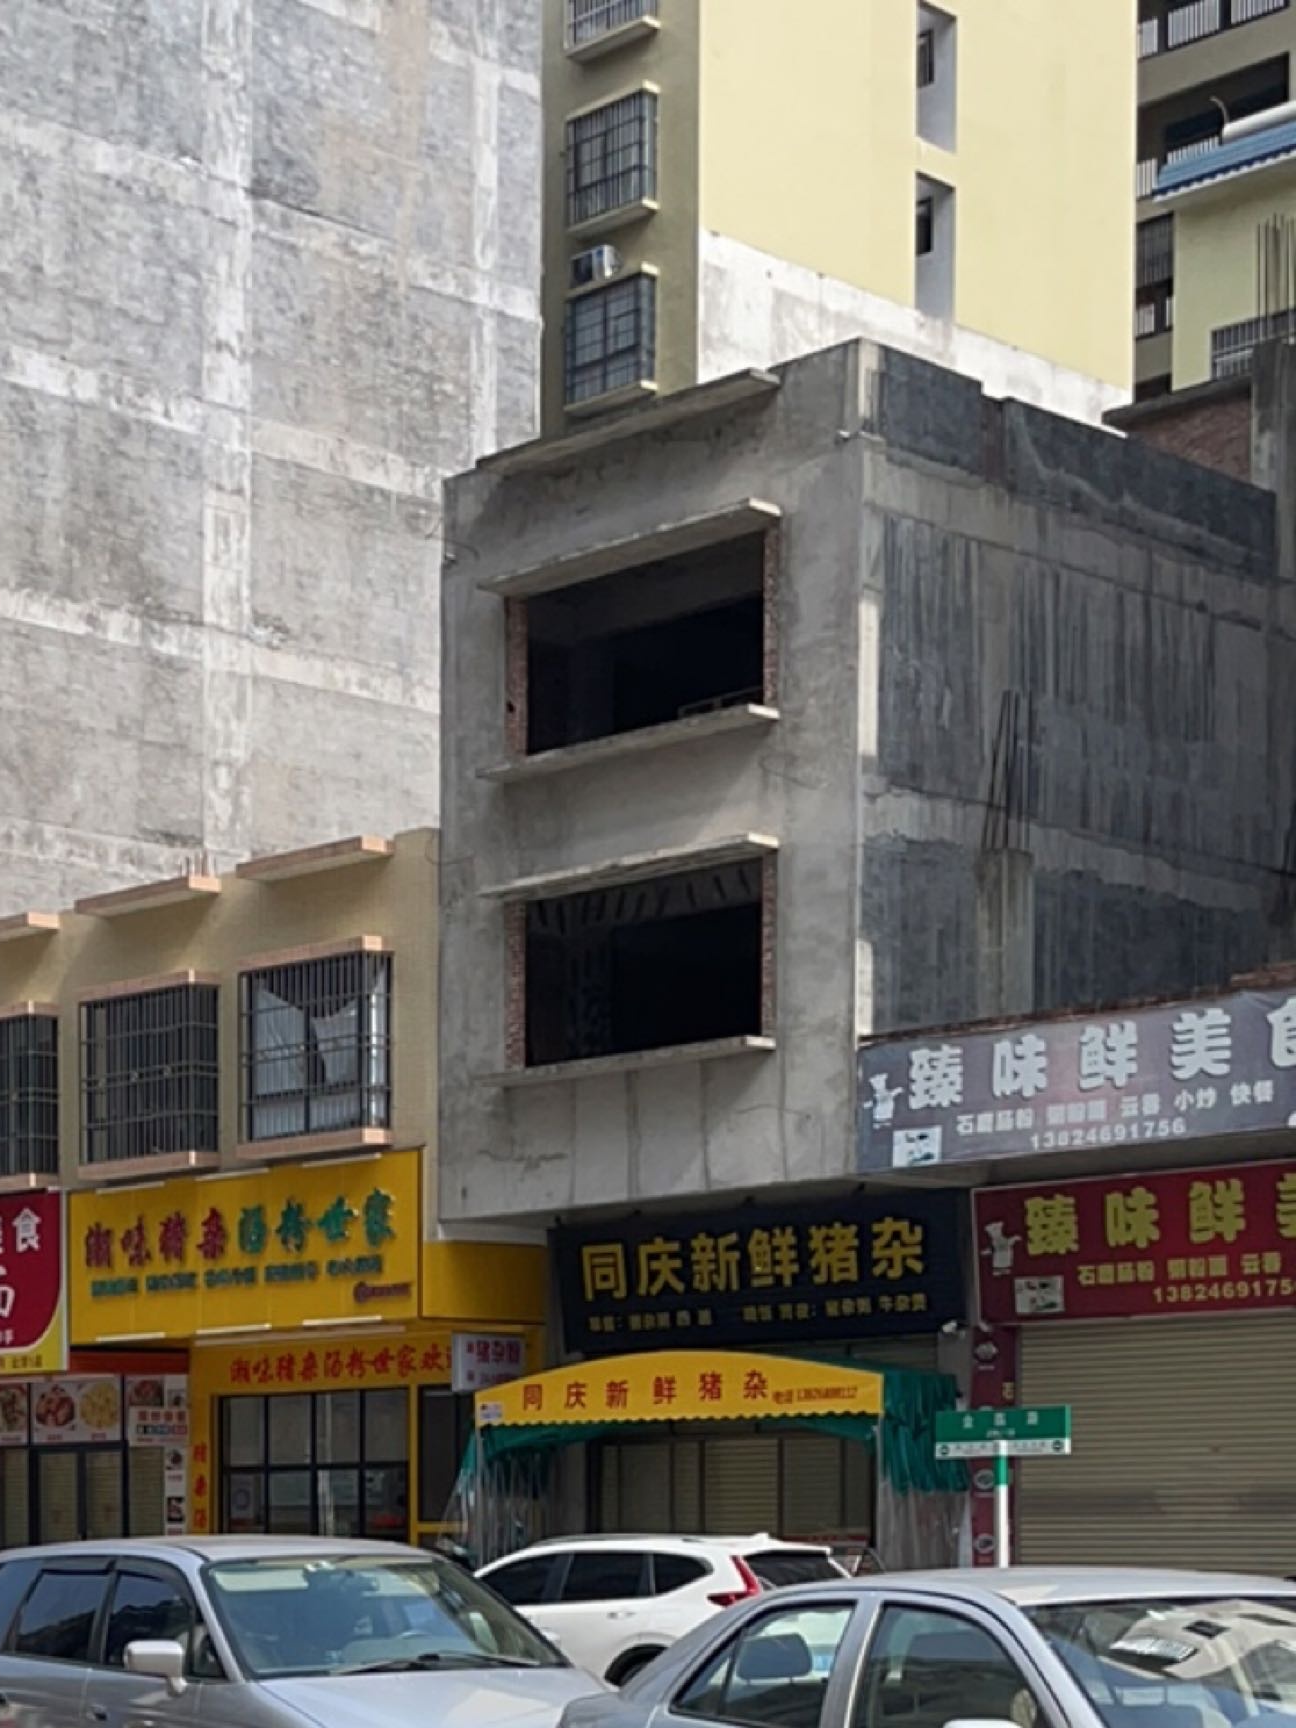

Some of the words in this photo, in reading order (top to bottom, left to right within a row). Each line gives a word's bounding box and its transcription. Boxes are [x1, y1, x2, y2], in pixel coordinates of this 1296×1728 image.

[1174, 1087, 1217, 1110] 小炒
[1231, 1080, 1274, 1105] 快餐
[581, 1216, 924, 1302] 同庆新鲜猪杂
[1153, 1278, 1296, 1304] 1382469175
[522, 1369, 768, 1411] 同庆新鲜猪杂
